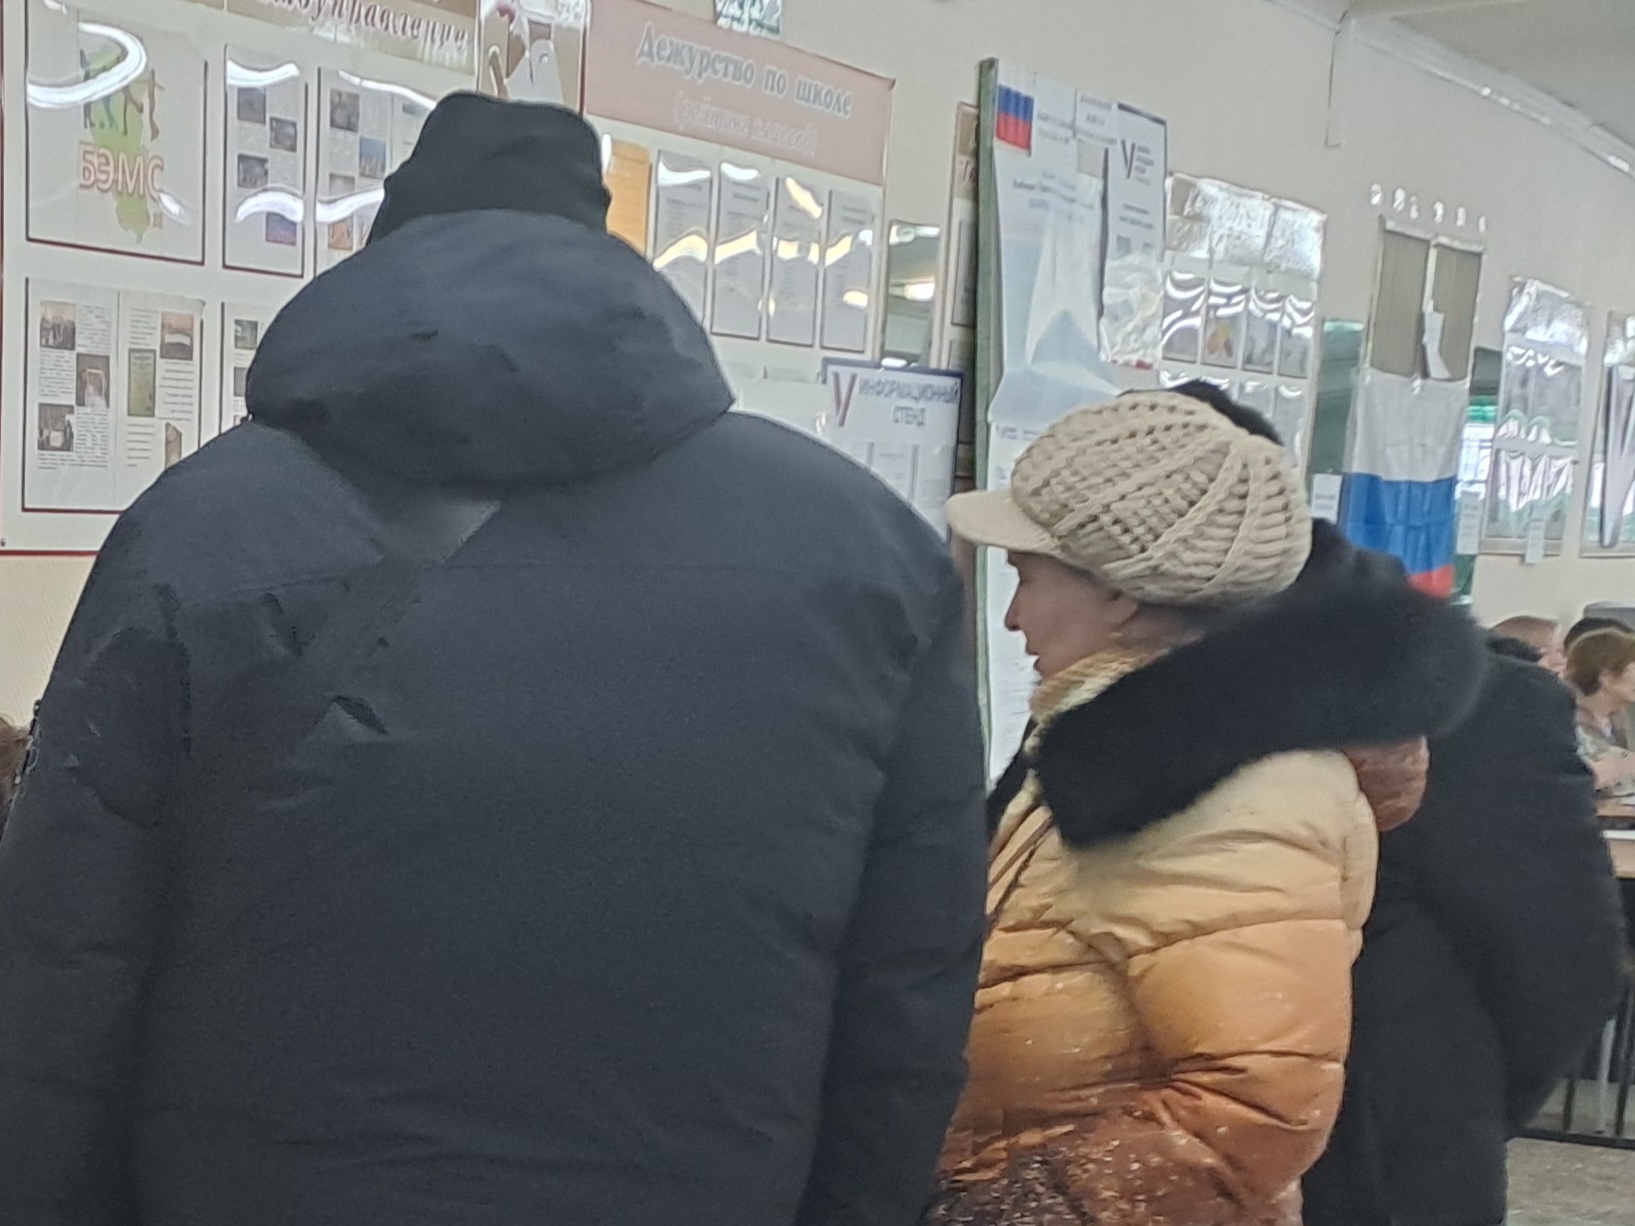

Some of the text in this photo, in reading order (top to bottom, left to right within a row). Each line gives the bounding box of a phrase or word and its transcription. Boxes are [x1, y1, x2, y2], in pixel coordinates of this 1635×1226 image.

[637, 21, 853, 117] Дежурство по школе
